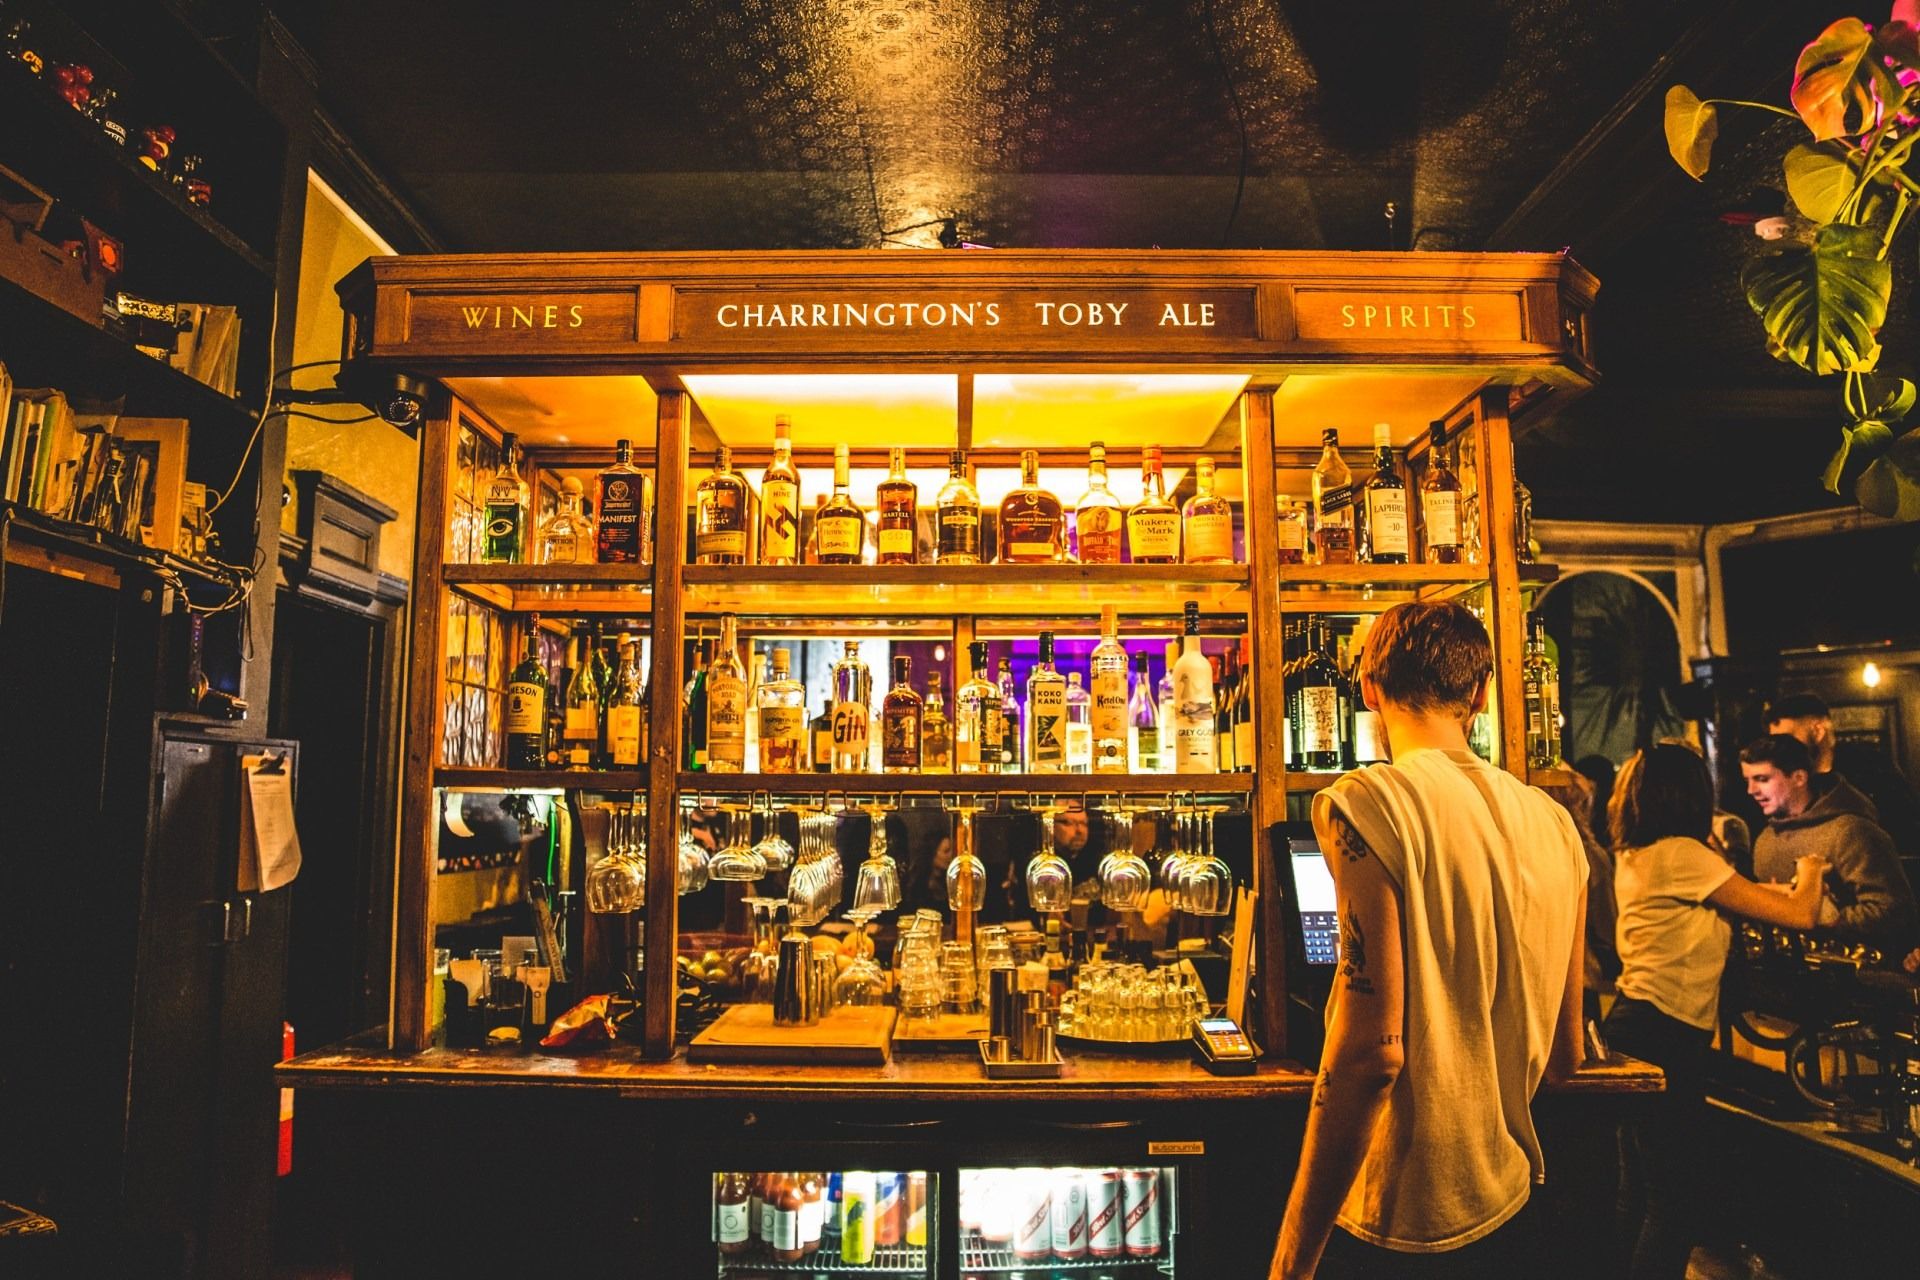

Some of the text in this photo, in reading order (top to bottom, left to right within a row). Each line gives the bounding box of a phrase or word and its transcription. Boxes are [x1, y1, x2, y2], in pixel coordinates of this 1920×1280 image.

[462, 305, 584, 329] WINES
[716, 302, 1216, 328] CHARRINGTON'S TOBY ALE
[1341, 304, 1476, 328] SPIRITS
[599, 514, 637, 524] MANIFEST
[1178, 729, 1195, 737] GREY
